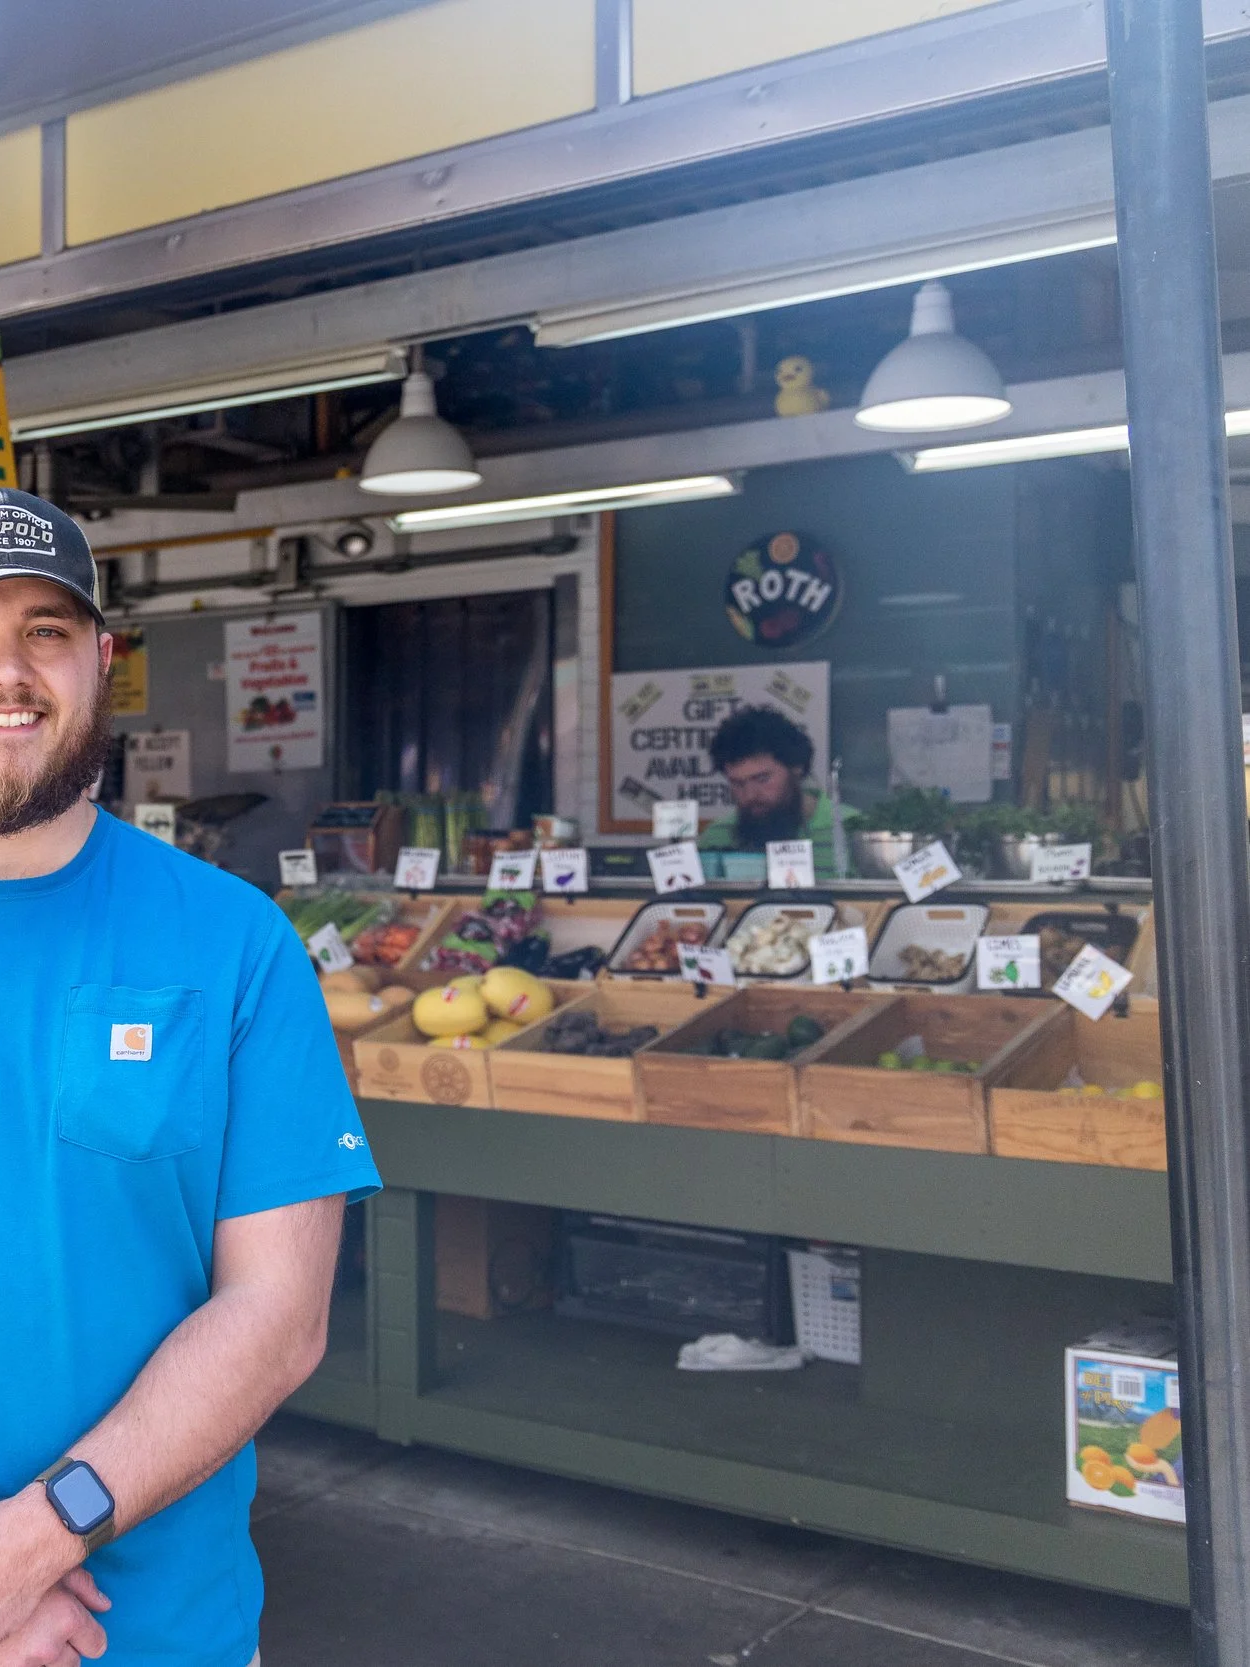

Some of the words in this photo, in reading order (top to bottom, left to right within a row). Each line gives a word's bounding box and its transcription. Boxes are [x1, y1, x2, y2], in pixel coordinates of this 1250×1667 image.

[12, 511, 46, 529] OPTICS
[14, 537, 36, 547] 1907
[731, 569, 832, 613] ROTH
[682, 697, 743, 721] GIFT
[677, 784, 739, 806] HER
